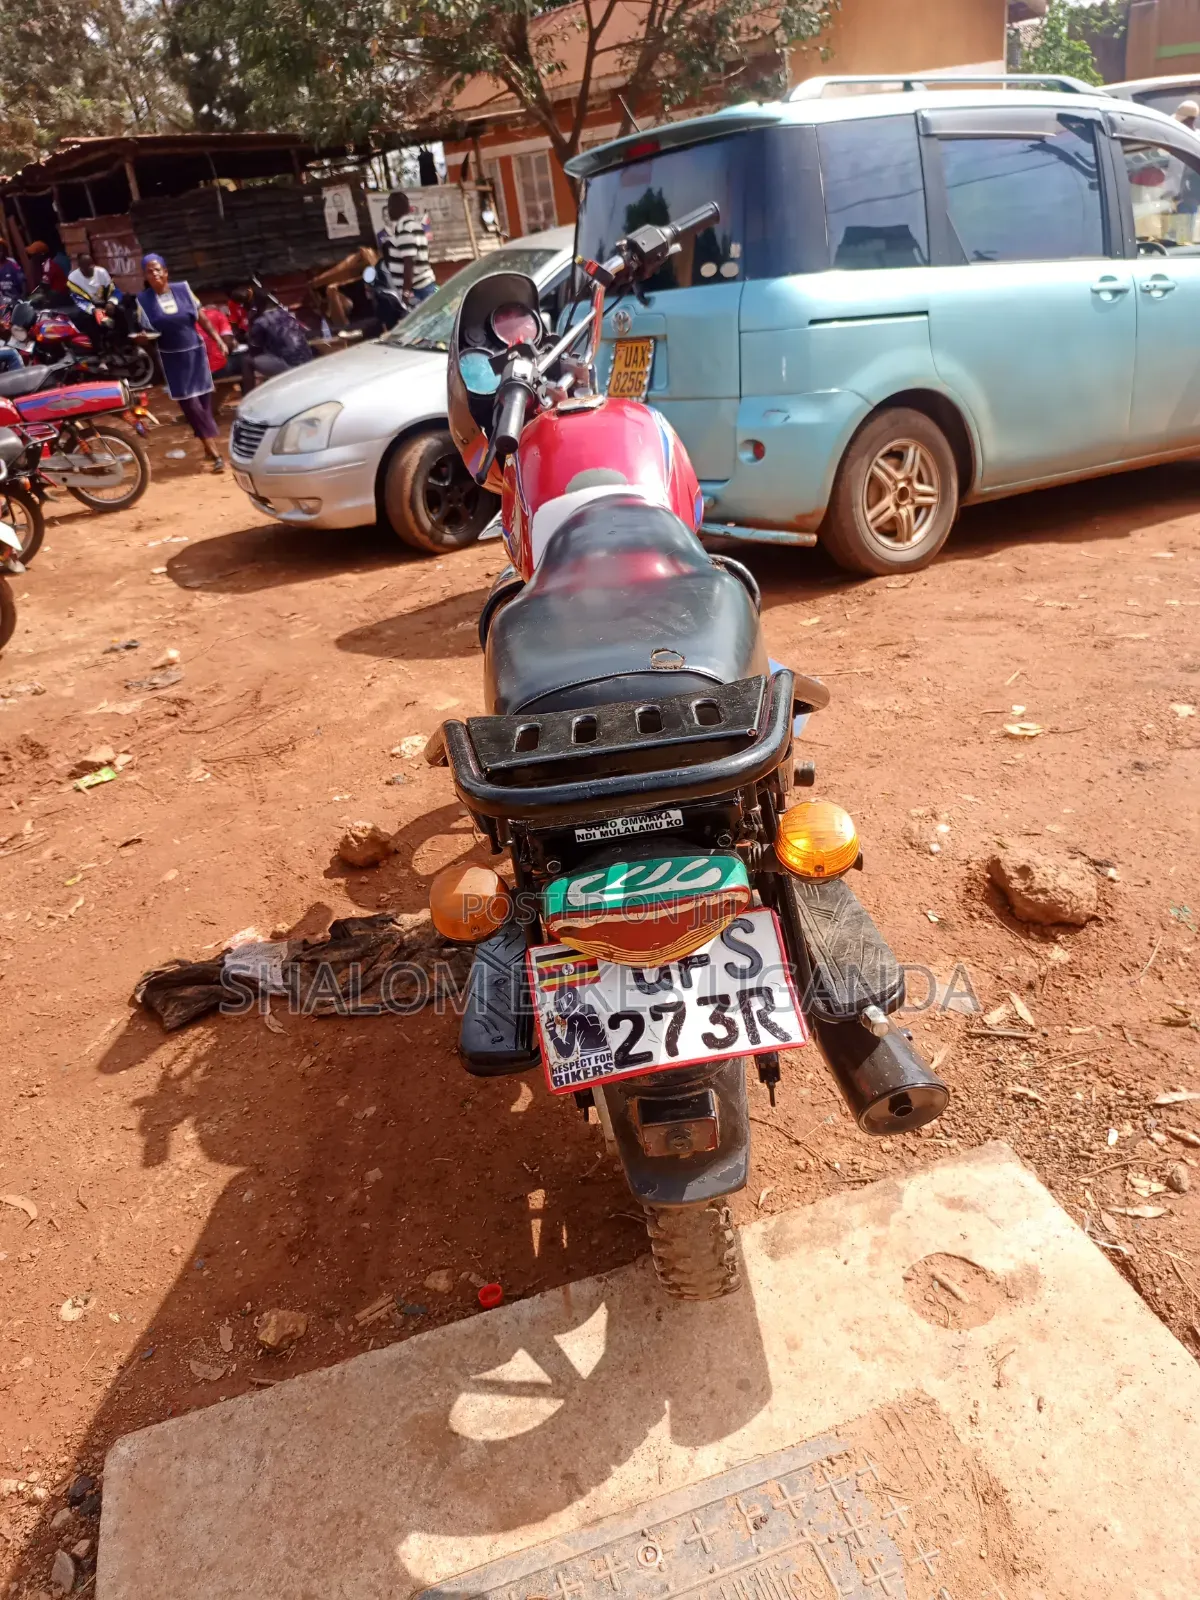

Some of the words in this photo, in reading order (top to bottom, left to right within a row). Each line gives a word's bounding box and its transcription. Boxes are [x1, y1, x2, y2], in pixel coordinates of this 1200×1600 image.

[624, 345, 648, 368] UAX
[613, 371, 644, 393] 825G
[577, 832, 597, 841] NDI
[600, 822, 662, 838] MULALAMU
[666, 818, 682, 828] KO
[607, 986, 793, 1070] 273R
[552, 1057, 592, 1075] RESPECT
[594, 1052, 613, 1064] FOR
[553, 1062, 614, 1087] BIKERS
